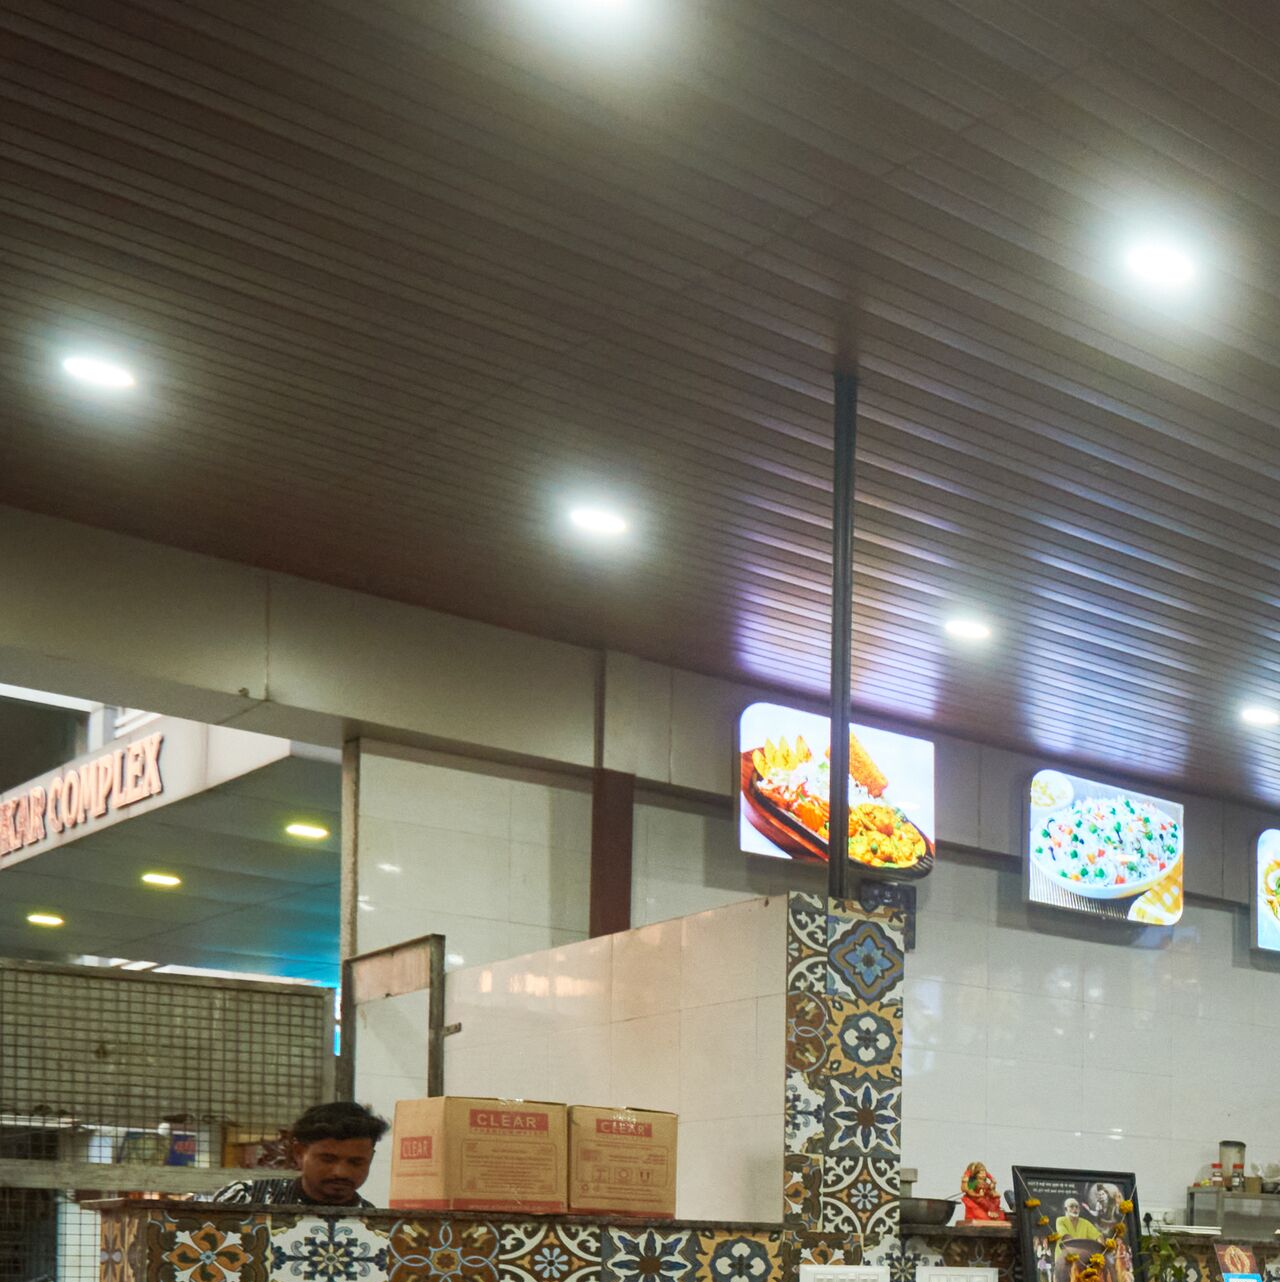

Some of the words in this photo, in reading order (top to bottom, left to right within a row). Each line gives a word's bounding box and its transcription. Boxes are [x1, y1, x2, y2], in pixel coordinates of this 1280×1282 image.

[50, 732, 163, 833] COMPLEX
[477, 1113, 537, 1128] CLEAR
[601, 1121, 645, 1135] CLEAR
[402, 1140, 430, 1158] CLEAR
